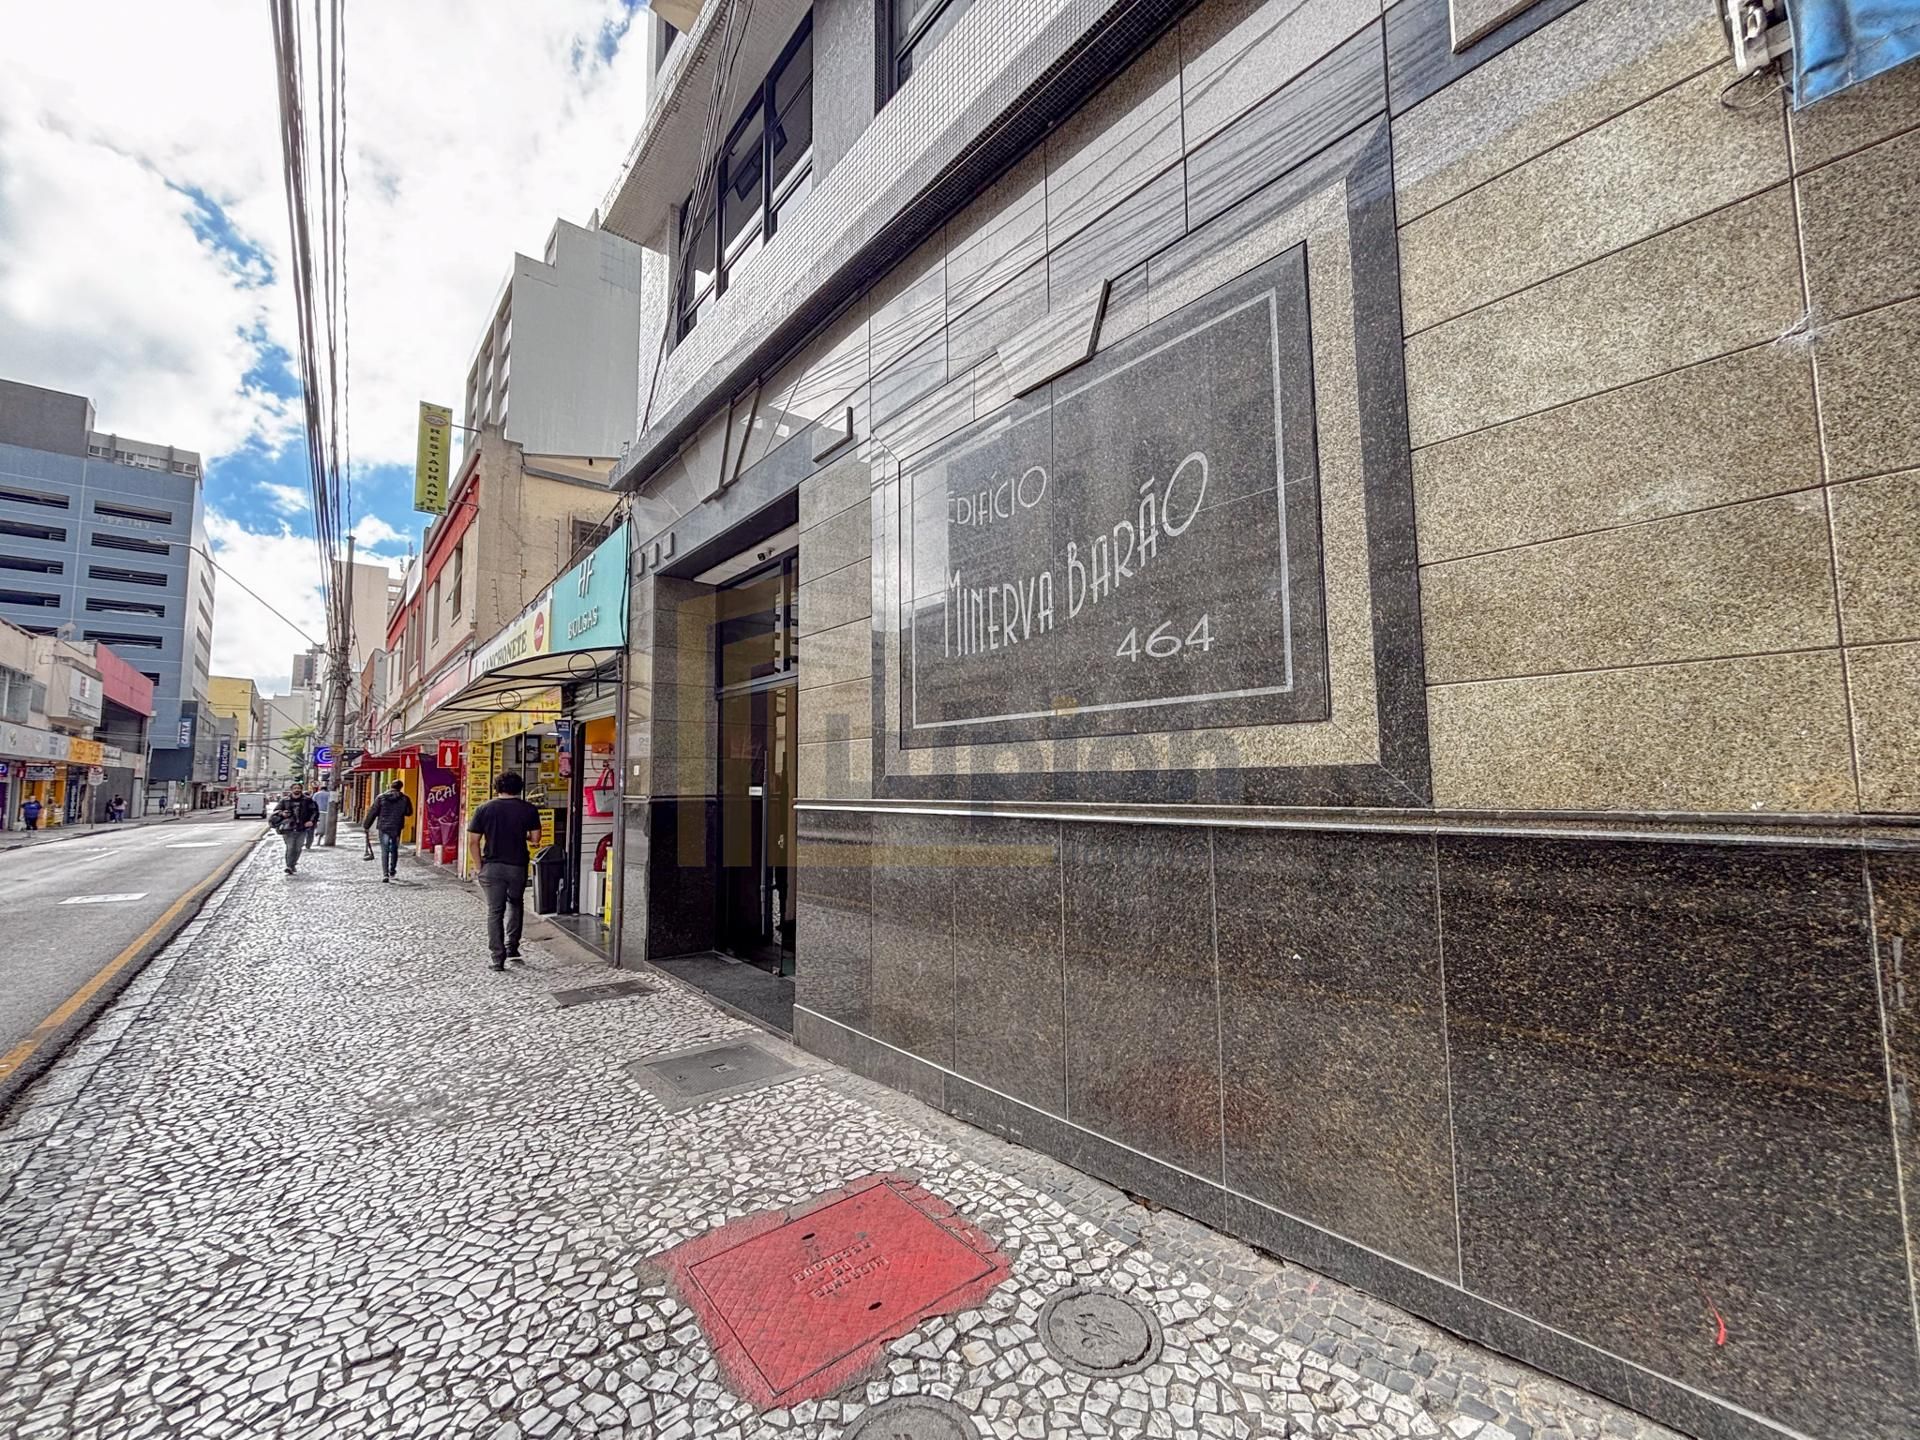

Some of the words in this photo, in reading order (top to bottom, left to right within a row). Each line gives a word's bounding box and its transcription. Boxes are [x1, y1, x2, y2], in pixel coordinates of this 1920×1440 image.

[426, 427, 441, 512] RESTAURANTE
[944, 569, 1053, 658] MINERVA
[1067, 452, 1208, 619] BARÃO
[568, 605, 599, 640] BOLSAS
[1116, 613, 1214, 662] 464
[831, 1261, 853, 1279] DE
